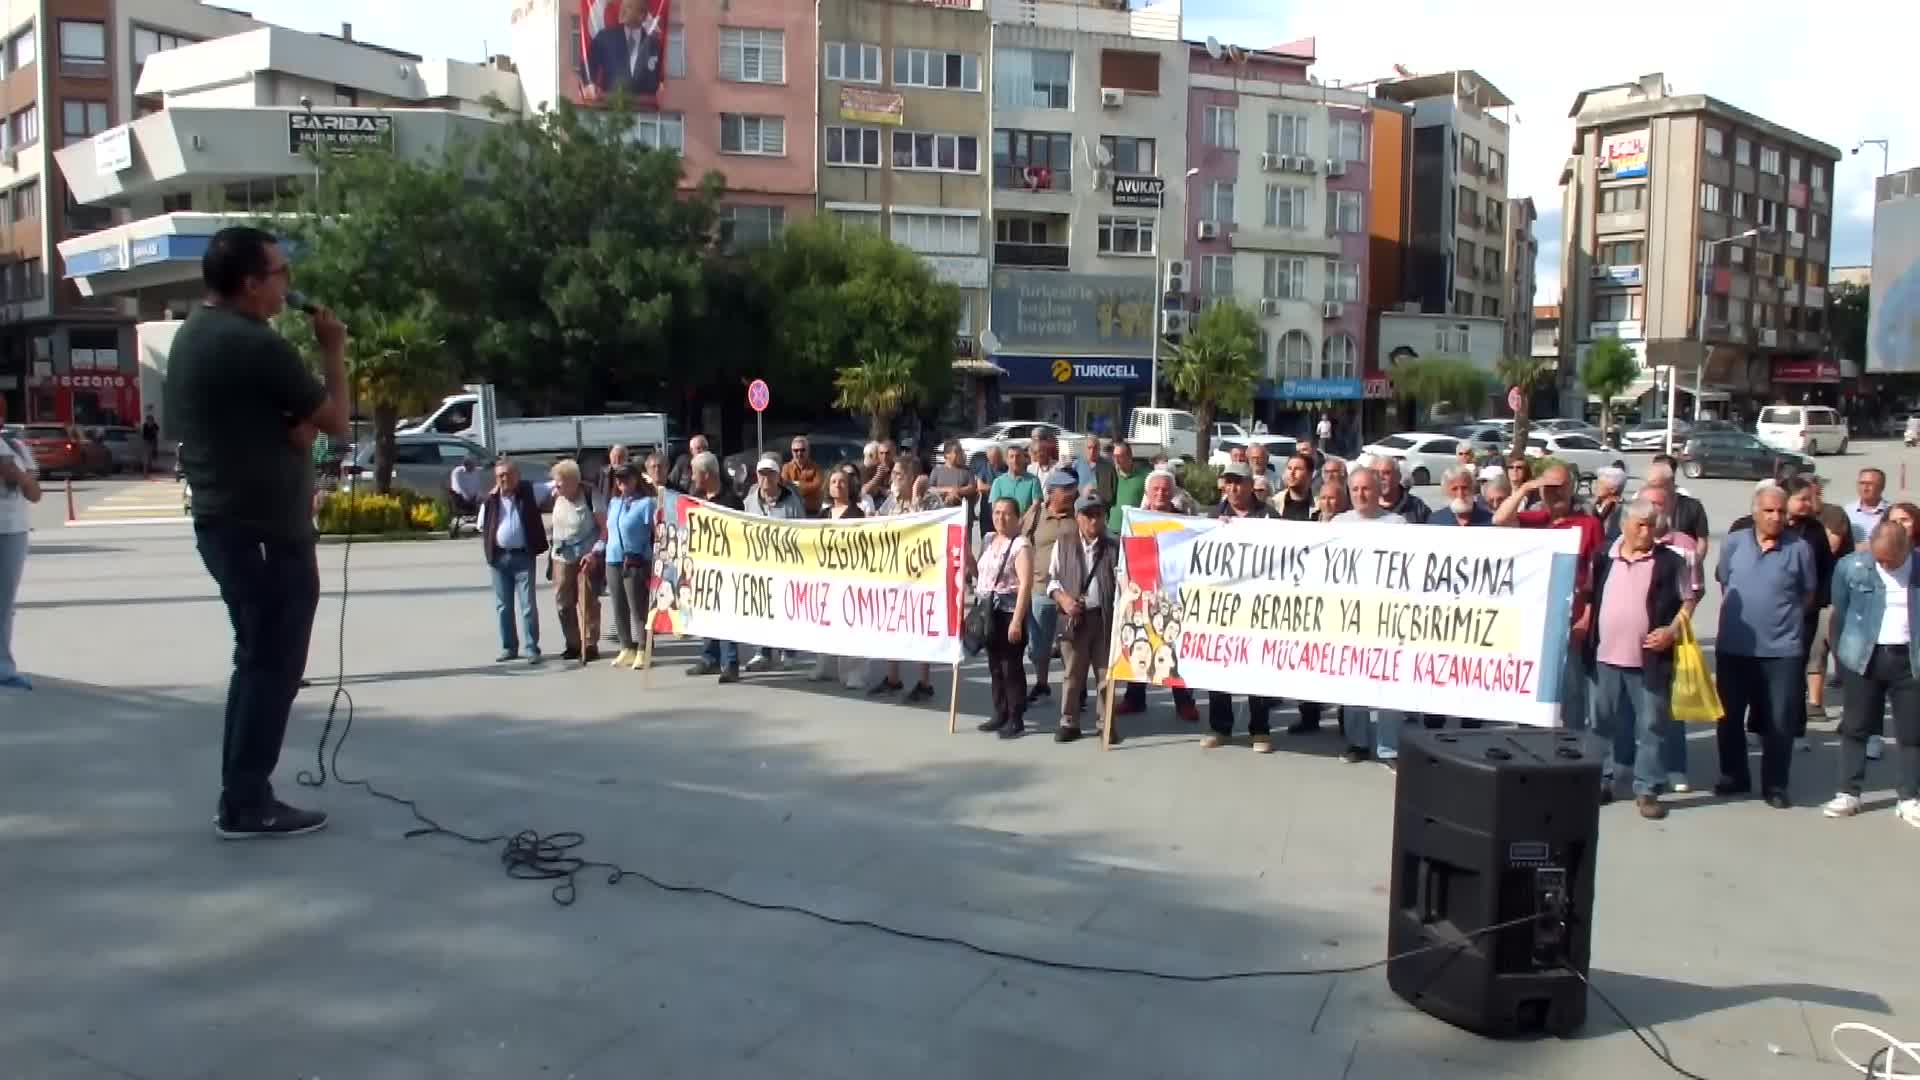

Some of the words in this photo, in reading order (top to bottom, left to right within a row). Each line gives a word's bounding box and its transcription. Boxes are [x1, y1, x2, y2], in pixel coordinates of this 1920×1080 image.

[1116, 180, 1161, 193] AVUKAT
[1073, 364, 1138, 378] TURKCELL
[688, 512, 731, 558] EMEK
[905, 537, 936, 578] için
[1190, 540, 1310, 587] KURTULUŞ
[1324, 544, 1363, 585] YOK
[1373, 550, 1415, 591] TEK
[1423, 552, 1515, 599] BAŞINA
[694, 568, 723, 612] HER
[731, 572, 774, 619] YERDE
[784, 579, 831, 626] OMUZ
[842, 584, 939, 636] OMUZAYIZ
[1179, 587, 1201, 624] YA
[1207, 590, 1241, 627] HEP
[1250, 593, 1324, 633] BERABER
[1340, 597, 1361, 635] YA
[1413, 652, 1534, 694] KAZANACAĞIZ
